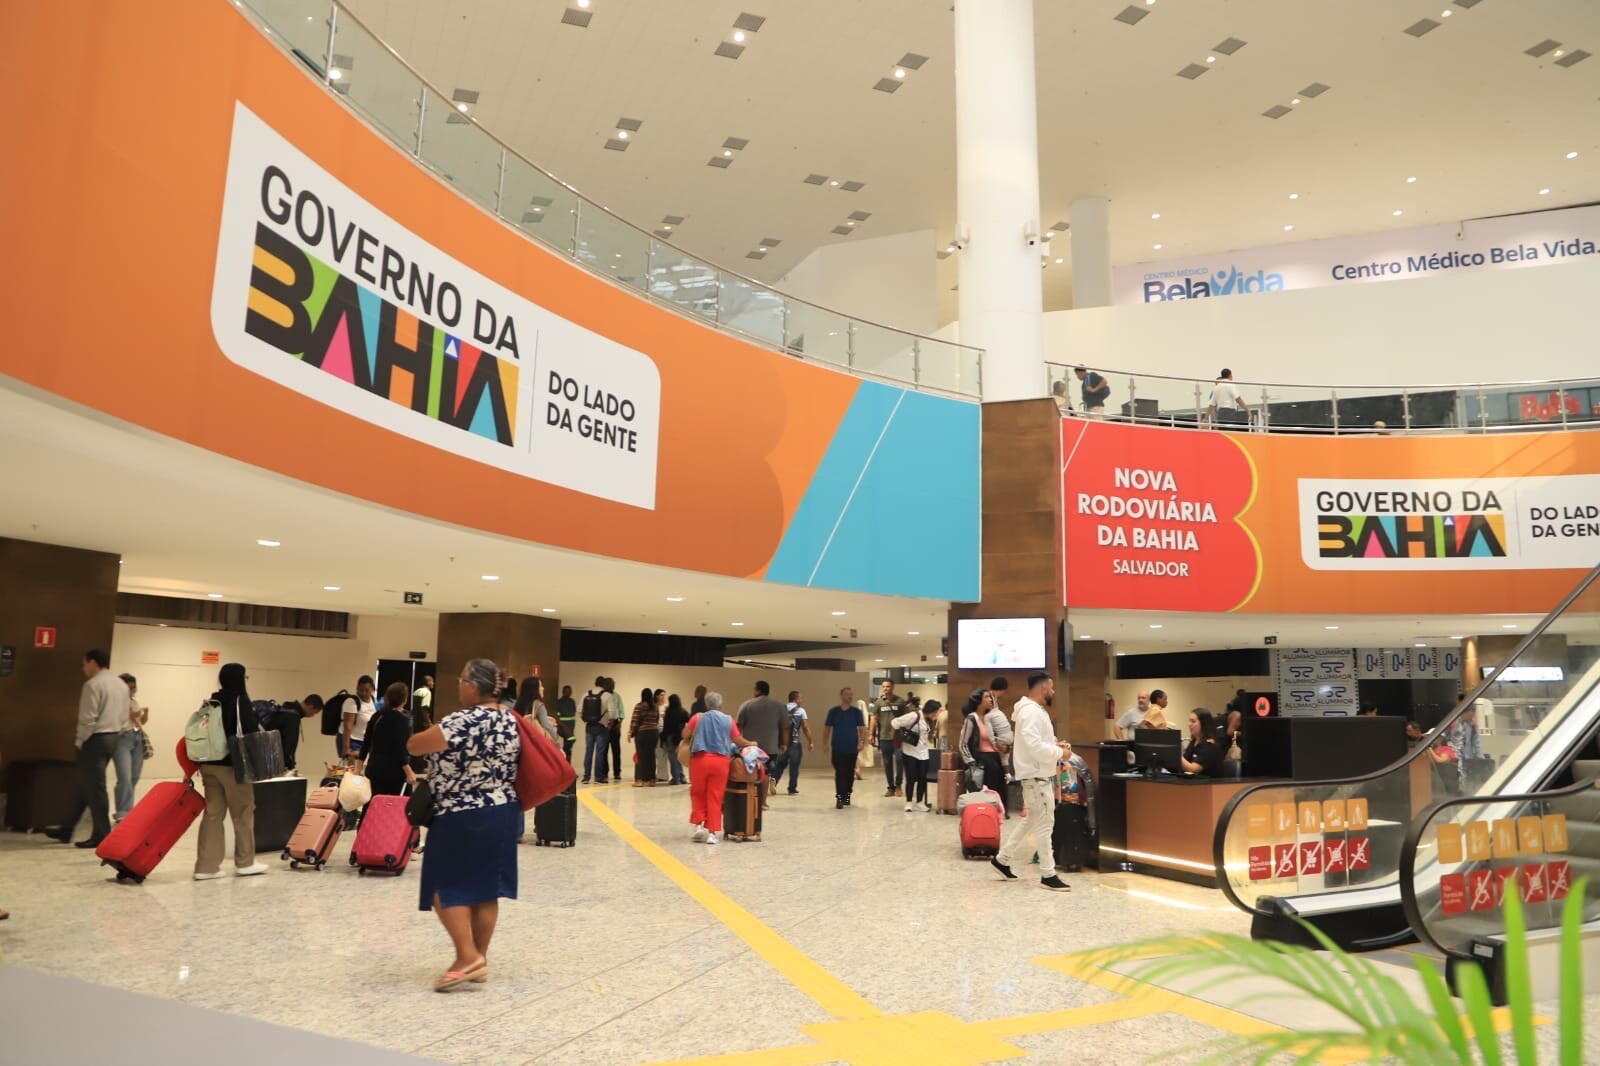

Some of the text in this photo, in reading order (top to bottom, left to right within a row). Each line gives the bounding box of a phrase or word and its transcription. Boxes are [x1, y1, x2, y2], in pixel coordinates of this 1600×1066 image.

[261, 165, 520, 360] GOVERNO DA
[1143, 267, 1209, 281] CENTRO MÉDICO
[1331, 261, 1402, 280] Centro
[1407, 252, 1485, 273] Médico
[1490, 243, 1539, 264] Bela
[244, 220, 519, 448] BAHIA
[548, 370, 636, 422] DO LADO
[546, 401, 638, 453] DA GENTE
[1114, 467, 1178, 492] NOVA
[1077, 493, 1218, 523] RODOVIÁRIA
[1316, 490, 1503, 513] GOVERNO DA
[1530, 505, 1599, 521] DO LAD
[1097, 524, 1200, 551] DA BAHIA
[1317, 514, 1508, 558] BAHIA
[1532, 524, 1557, 538] DA
[1113, 558, 1189, 577] SALVADOR
